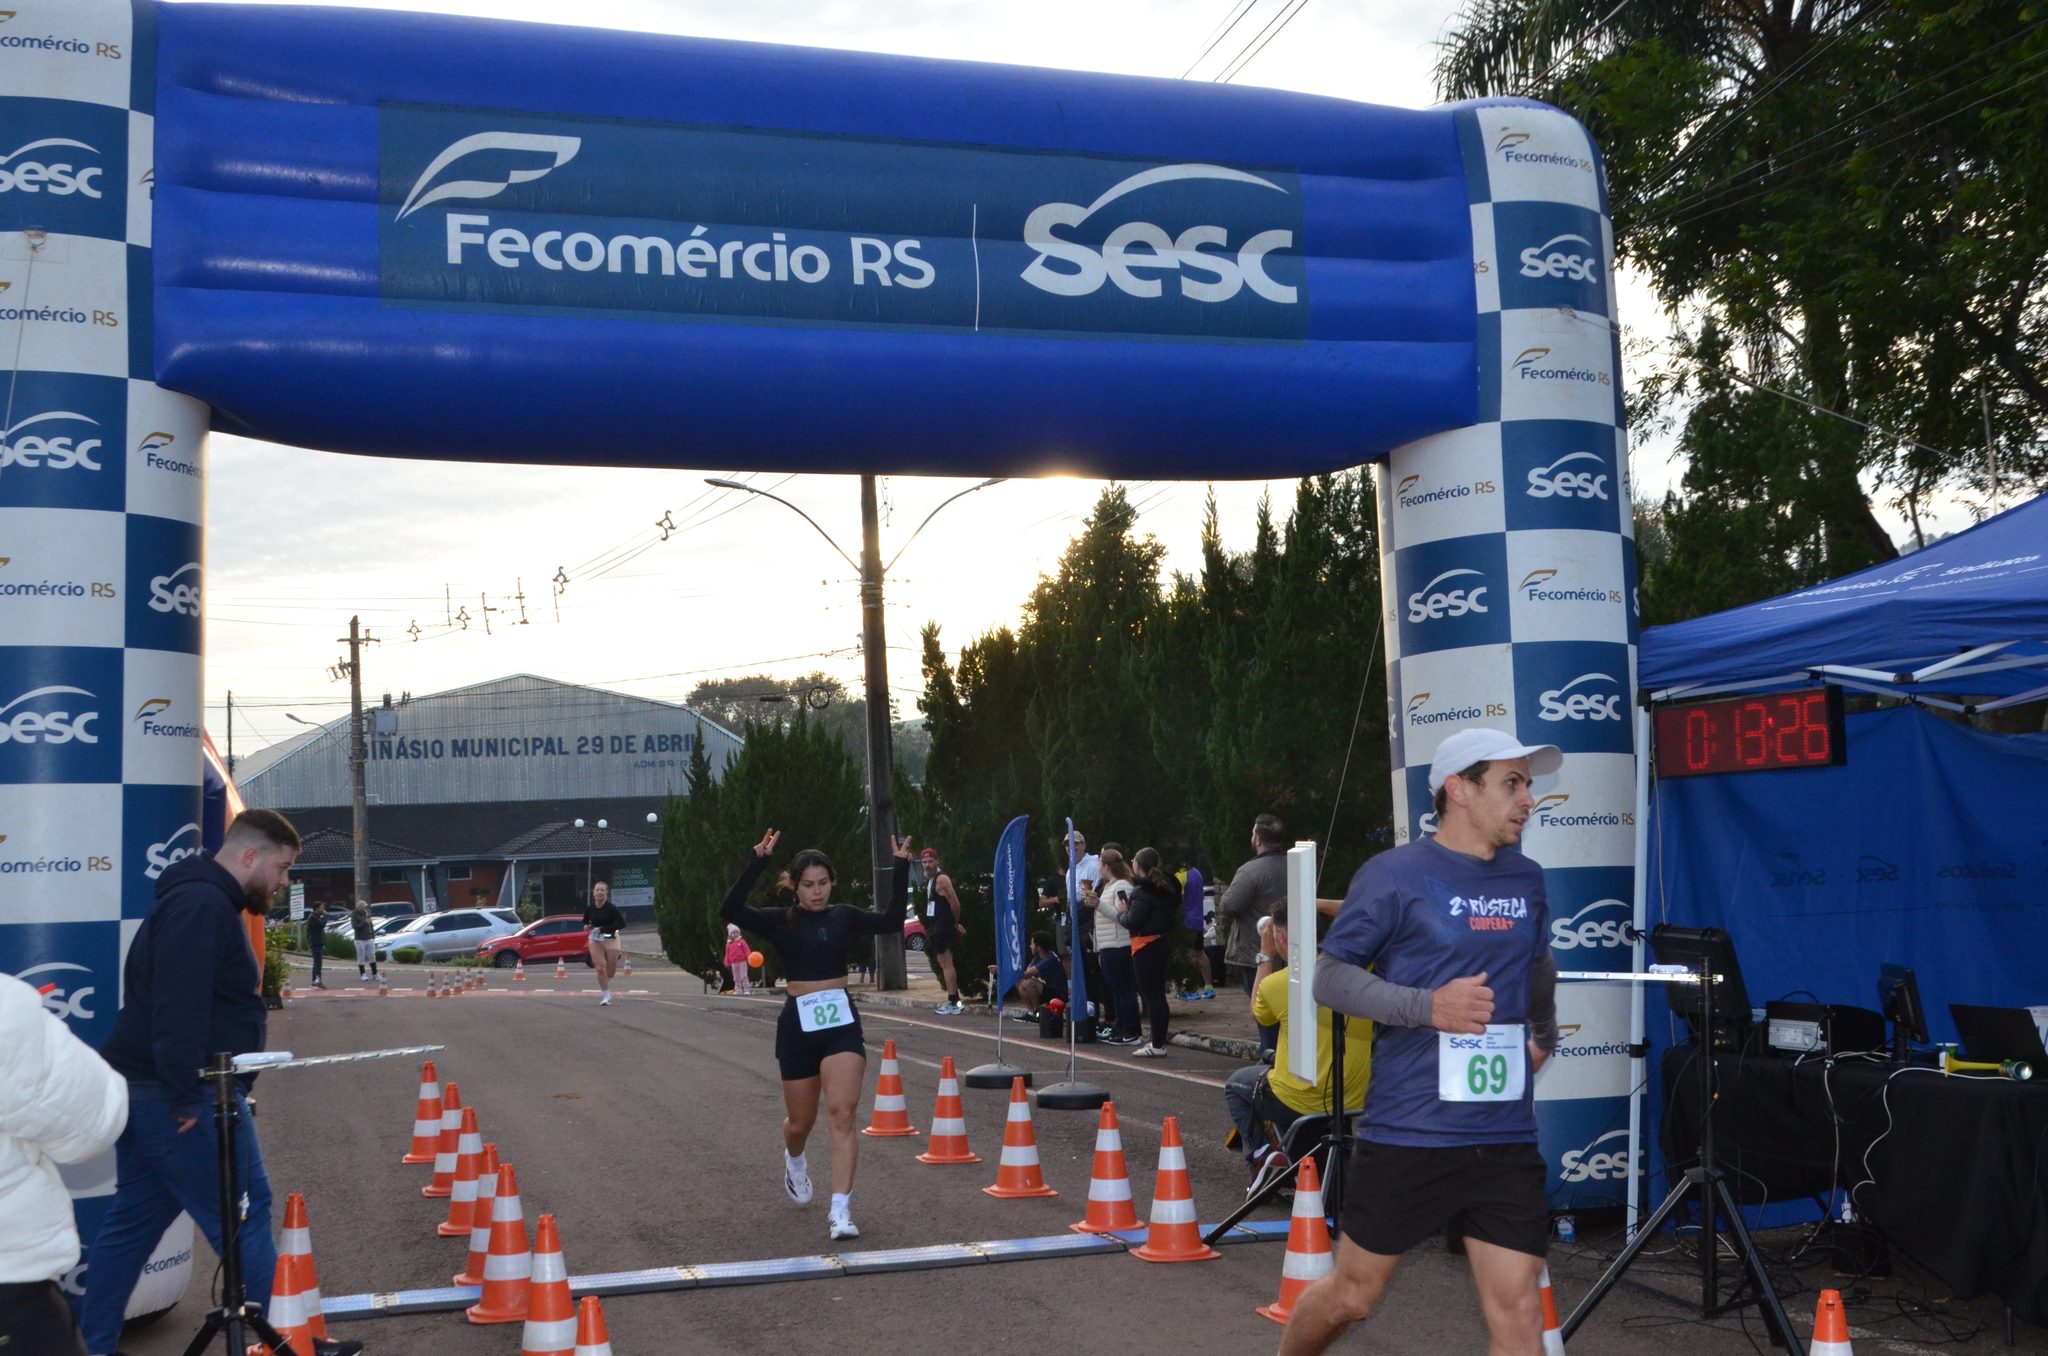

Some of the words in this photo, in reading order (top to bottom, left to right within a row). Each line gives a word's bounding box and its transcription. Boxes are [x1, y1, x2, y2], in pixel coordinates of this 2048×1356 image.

[0, 35, 90, 53] comércio
[95, 41, 122, 60] RS
[1505, 151, 1578, 169] Fecomércio
[1580, 159, 1593, 173] RS
[1020, 163, 1298, 304] Sesc
[446, 213, 831, 284] Fecomércio
[850, 236, 936, 289] RS
[1520, 234, 1597, 284] Sesc
[0, 305, 87, 324] comércio
[92, 309, 118, 327] RS
[1521, 367, 1596, 383] Fecomércio
[1598, 371, 1611, 386] RS
[147, 452, 203, 479] Fecomérc
[1526, 452, 1609, 500] Sesc
[1400, 484, 1470, 510] Fecomércio
[1474, 480, 1496, 495] RS
[0, 580, 85, 597] omércio
[91, 582, 116, 598] RS
[148, 562, 202, 617] Ses
[1408, 568, 1488, 623] Sesc
[1529, 588, 1607, 602] Fecomércio
[1609, 590, 1622, 604] RS
[1538, 672, 1622, 721] Sesc
[1411, 707, 1481, 726] Fecomércio
[1486, 703, 1507, 717] RS
[1686, 694, 1830, 770] 0:13:26
[452, 735, 570, 760] MUNICIPAL
[576, 735, 605, 756] 29
[610, 734, 637, 754] DE
[1540, 812, 1619, 827] Fecomércio
[1621, 812, 1635, 826] RS
[0, 856, 82, 873] omércio
[87, 856, 112, 872] RS
[1550, 899, 1635, 949] Sesc
[813, 1003, 840, 1026] 82
[1450, 1037, 1482, 1049] Sesc
[1467, 1054, 1508, 1096] 69
